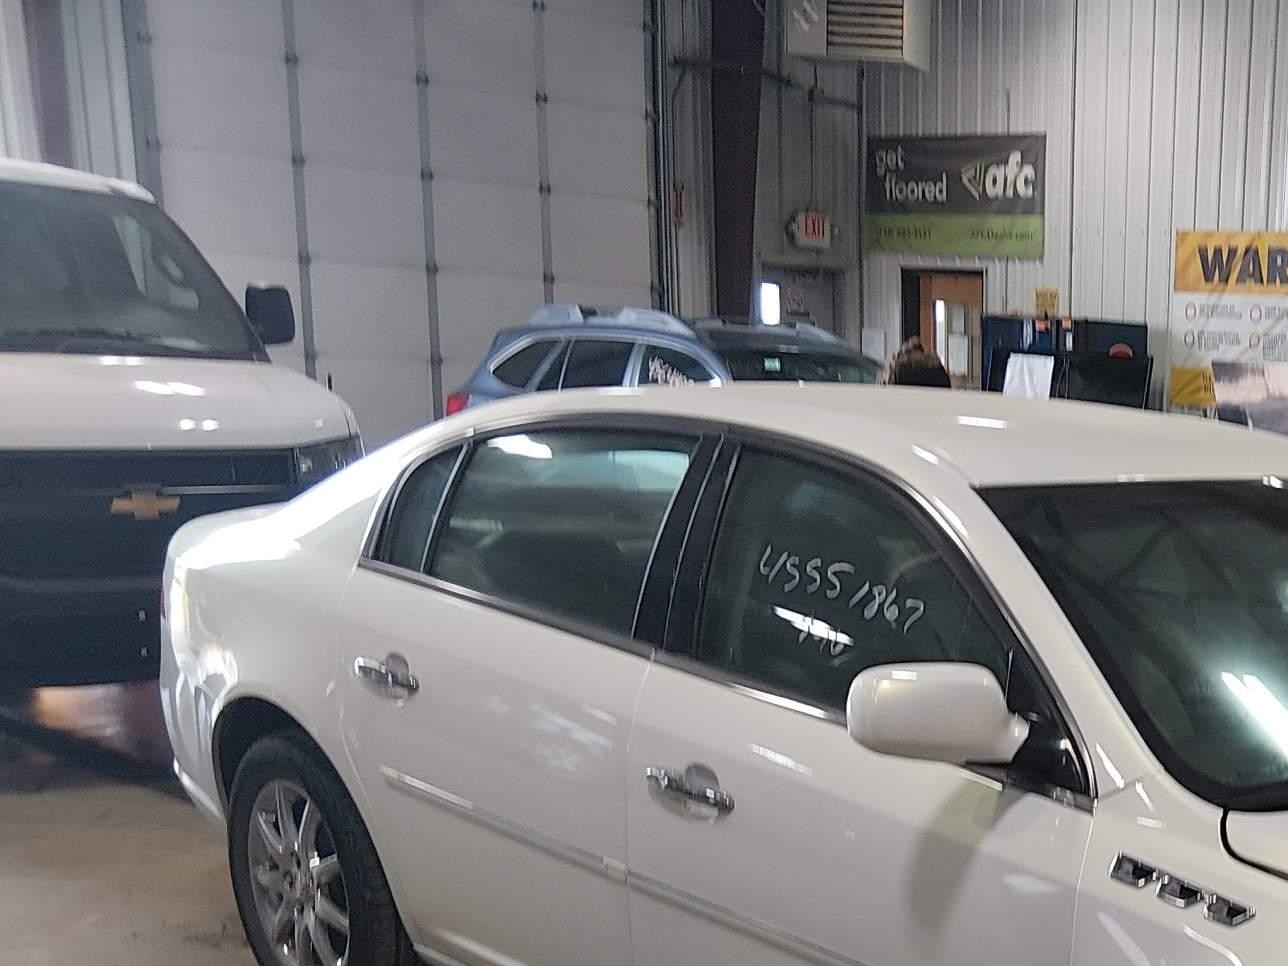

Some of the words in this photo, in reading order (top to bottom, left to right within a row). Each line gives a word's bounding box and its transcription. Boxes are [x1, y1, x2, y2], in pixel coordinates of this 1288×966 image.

[875, 144, 904, 176] get
[985, 150, 1036, 199] afc
[885, 171, 947, 203] floored
[804, 215, 825, 238] EXIT
